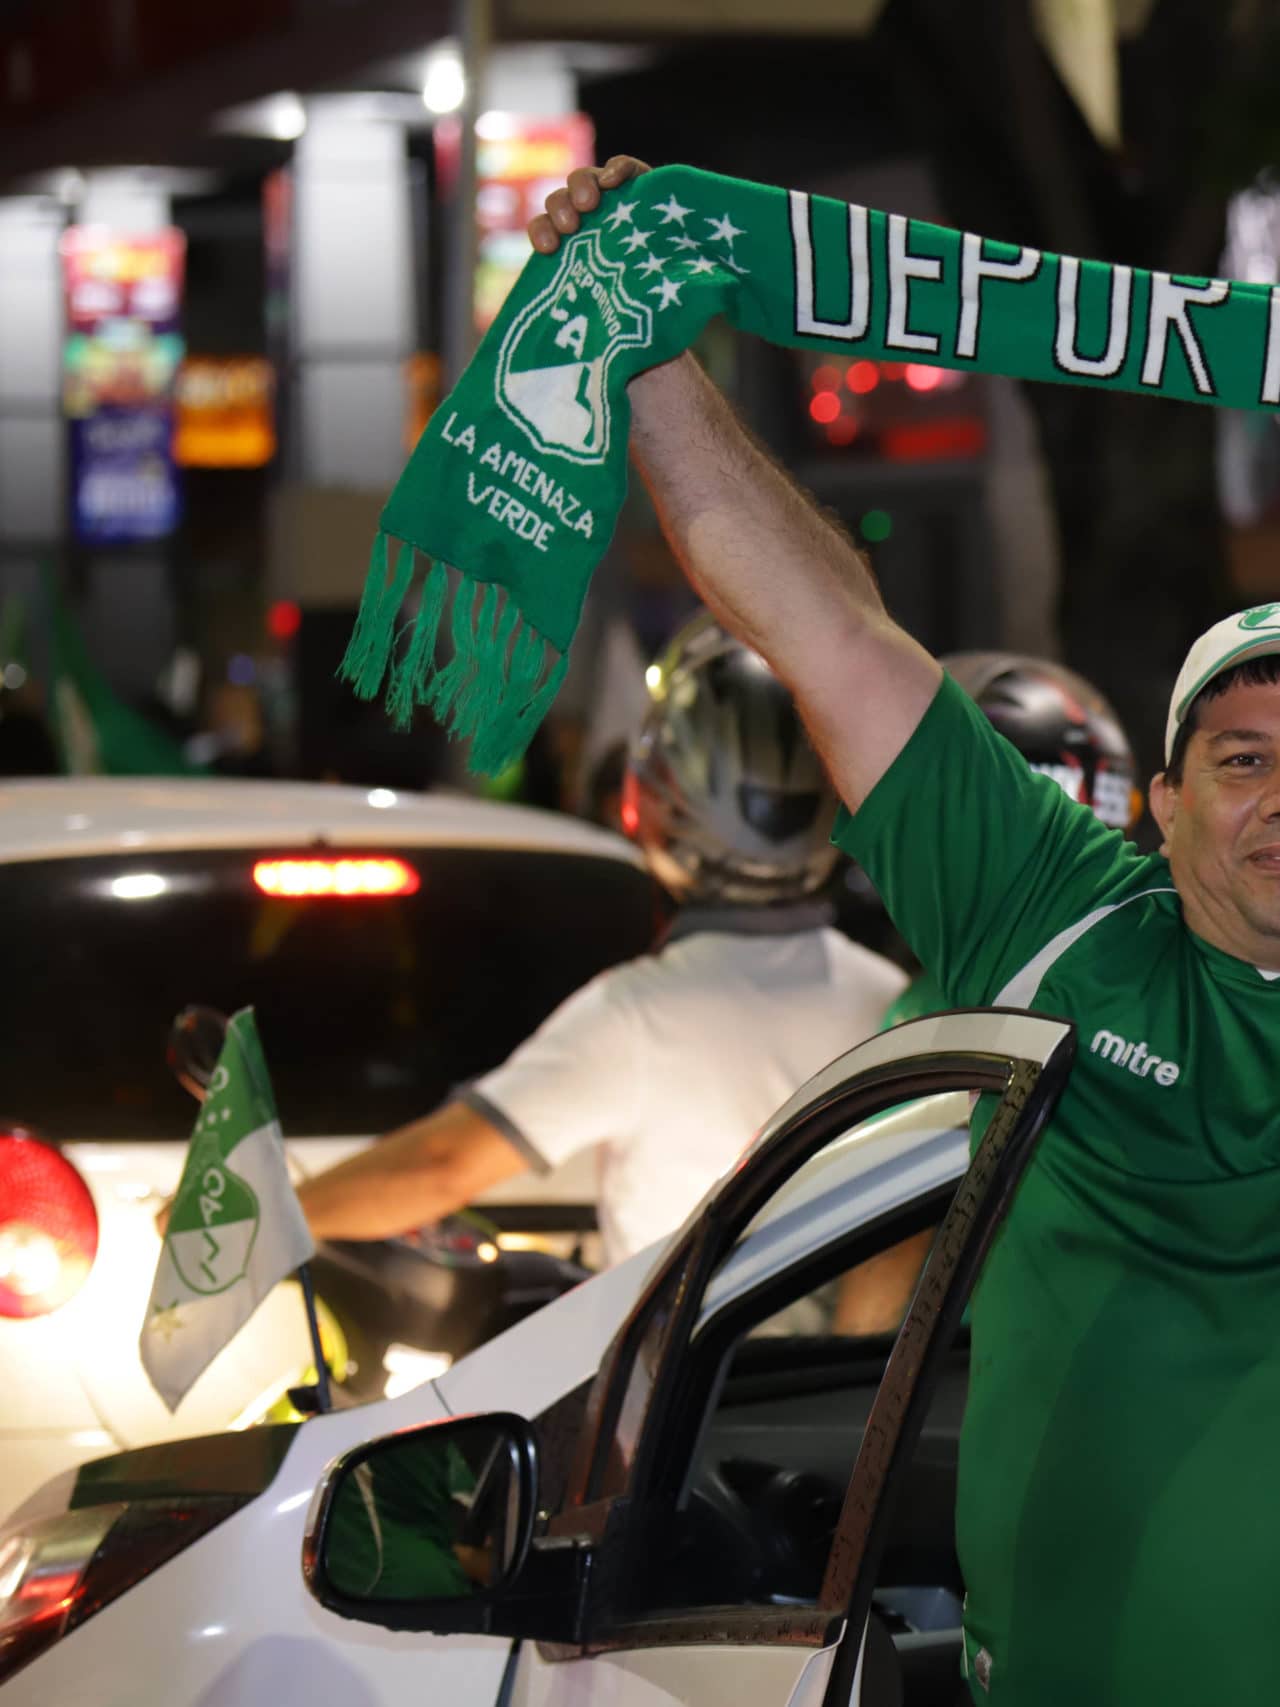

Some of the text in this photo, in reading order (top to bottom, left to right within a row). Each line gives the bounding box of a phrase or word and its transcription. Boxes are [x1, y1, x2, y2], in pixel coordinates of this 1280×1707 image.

[441, 411, 594, 539] LA AMENAZA
[467, 471, 555, 552] VERDE
[1090, 1029, 1180, 1087] mitre
